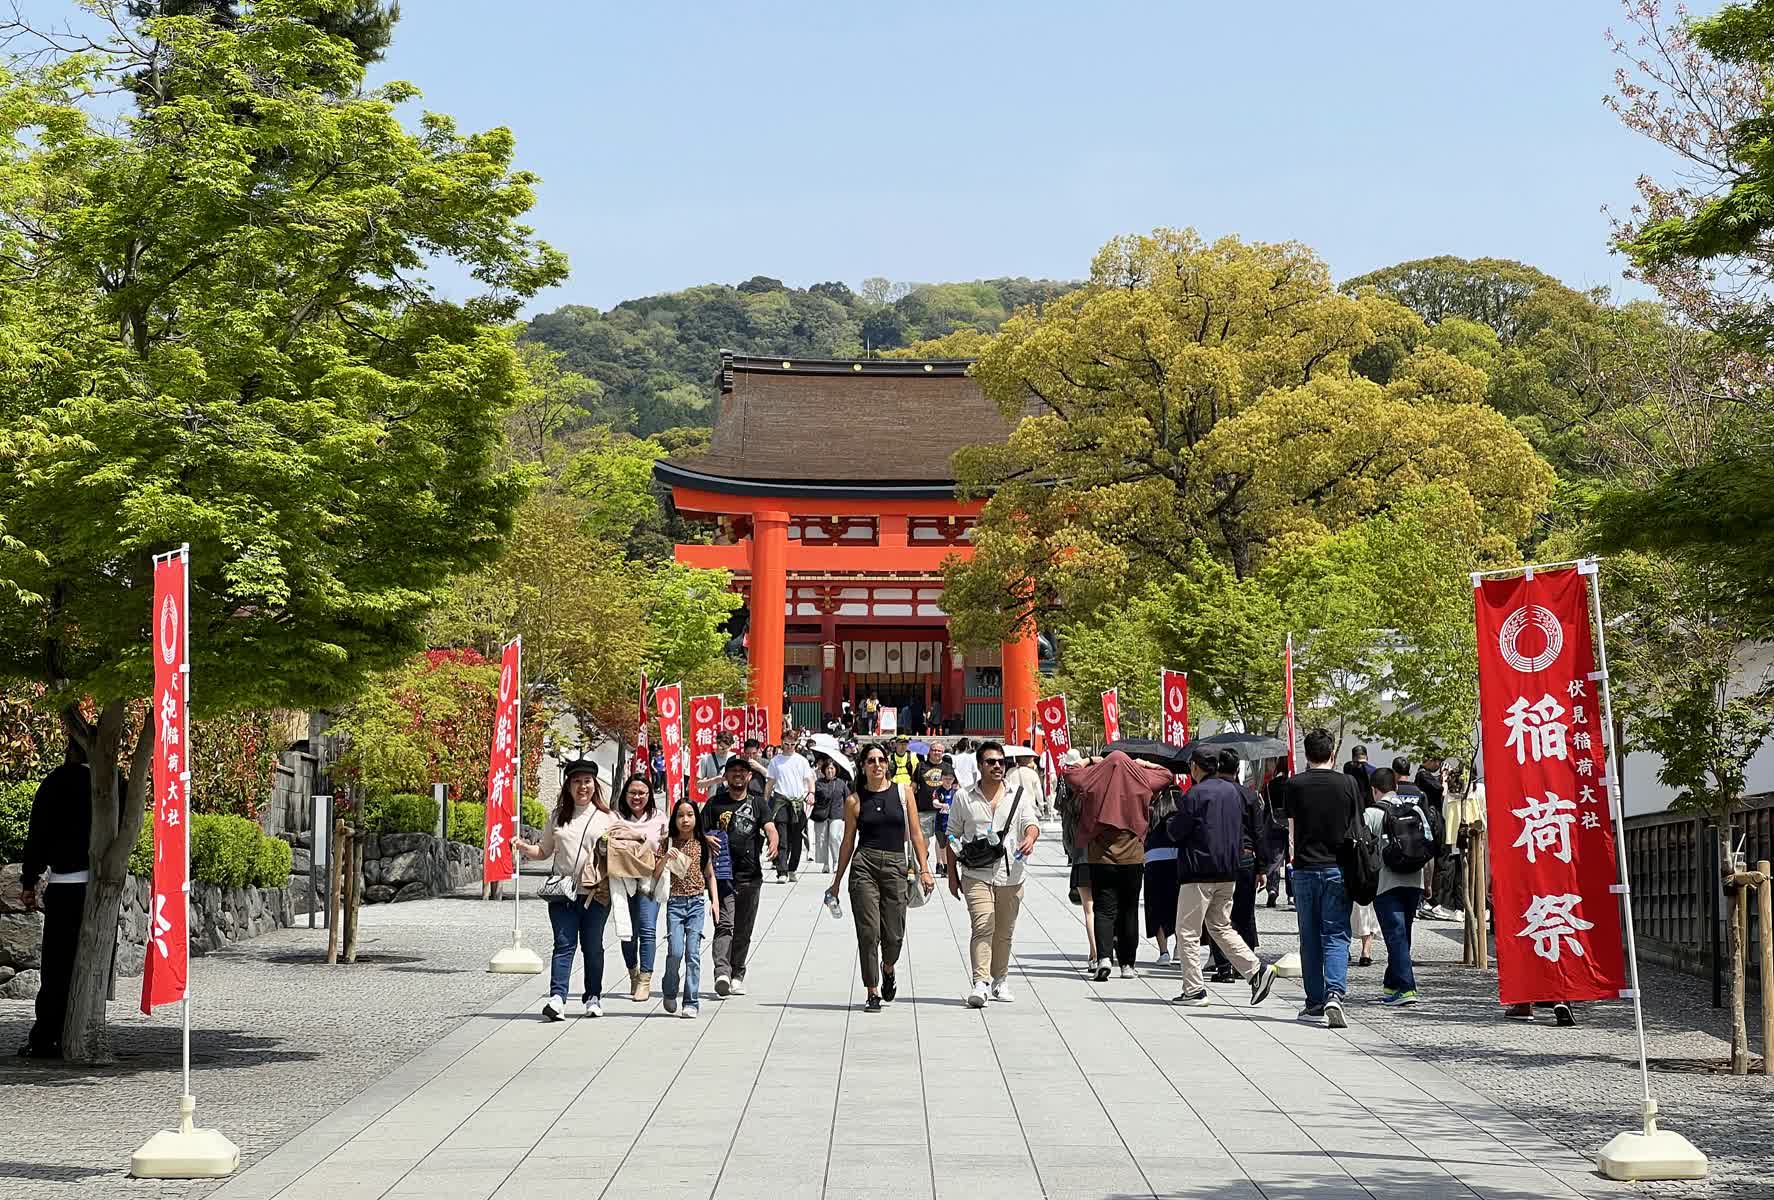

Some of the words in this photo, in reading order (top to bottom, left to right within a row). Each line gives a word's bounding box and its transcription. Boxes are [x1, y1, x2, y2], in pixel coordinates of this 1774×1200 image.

[488, 714, 507, 862] 稲荷祭
[1503, 693, 1594, 963] 稲荷祭
[1566, 679, 1601, 830] 伏見稲荷大社
